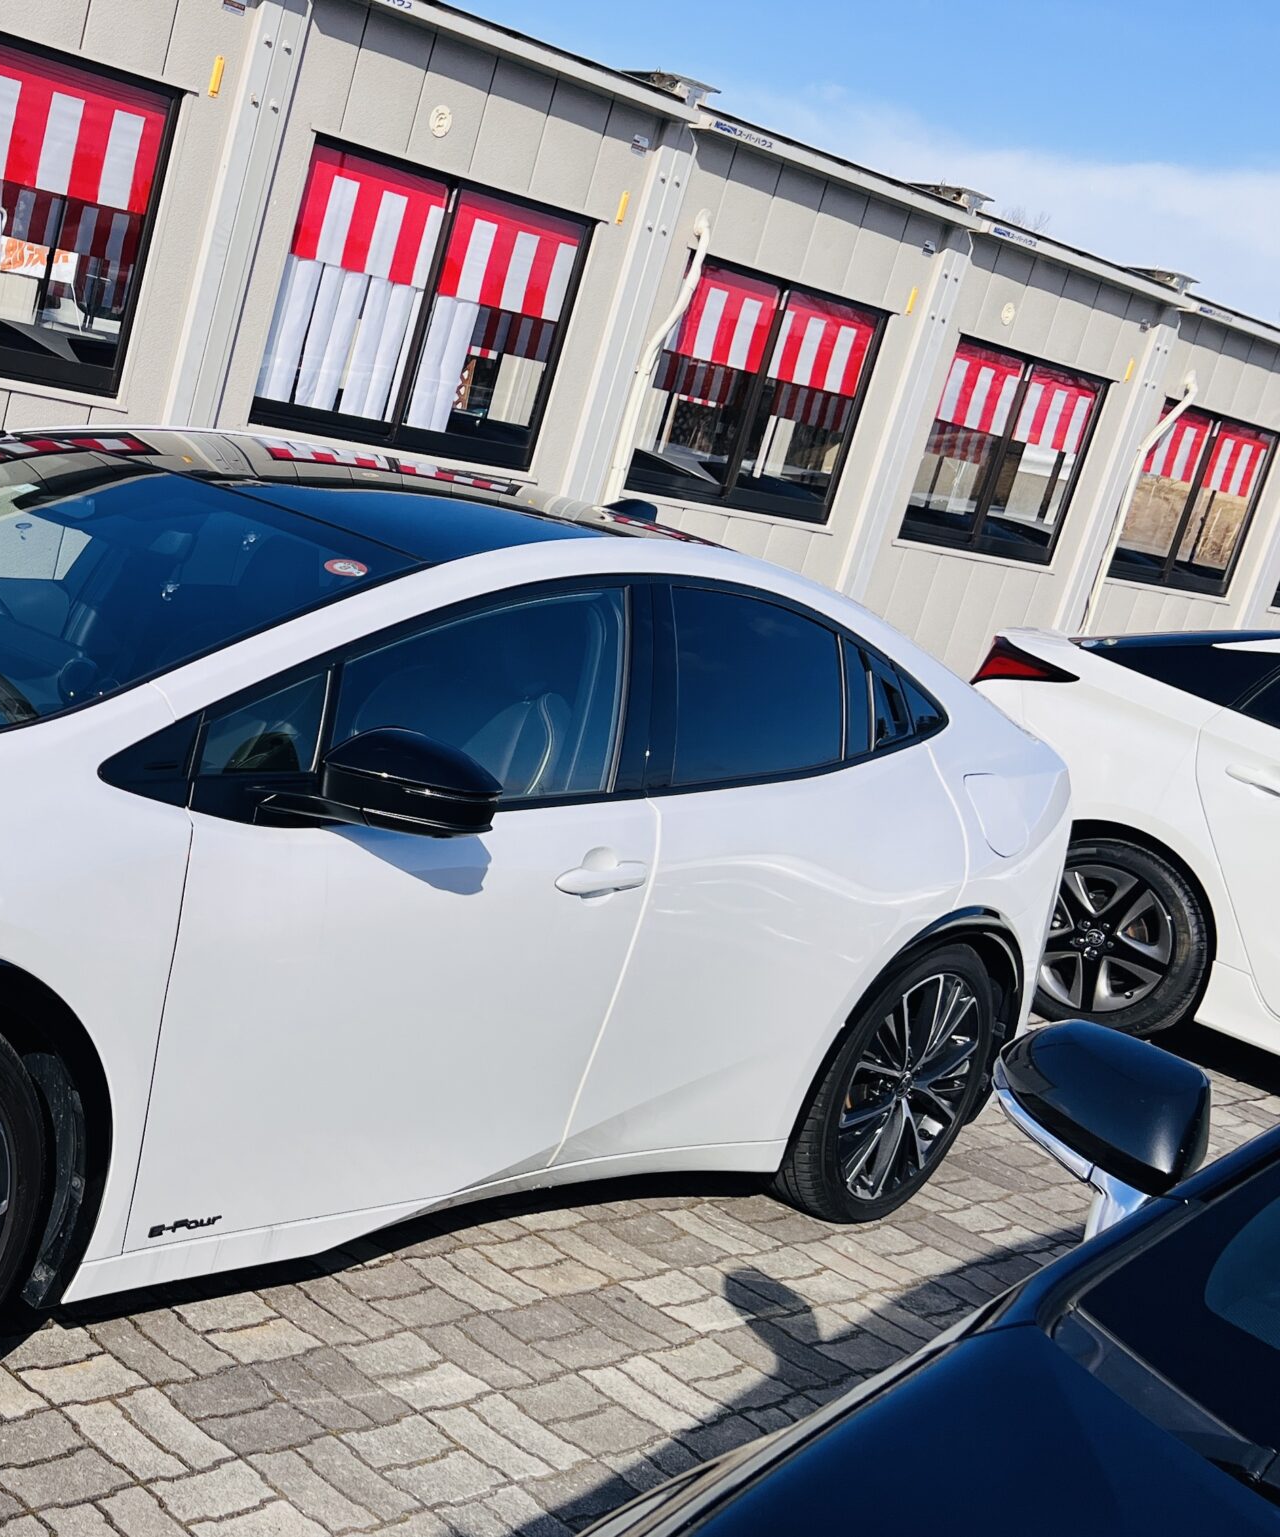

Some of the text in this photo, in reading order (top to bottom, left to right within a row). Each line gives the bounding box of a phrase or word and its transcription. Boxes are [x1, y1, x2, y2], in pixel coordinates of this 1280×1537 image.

[736, 129, 773, 149] スーパーハウス
